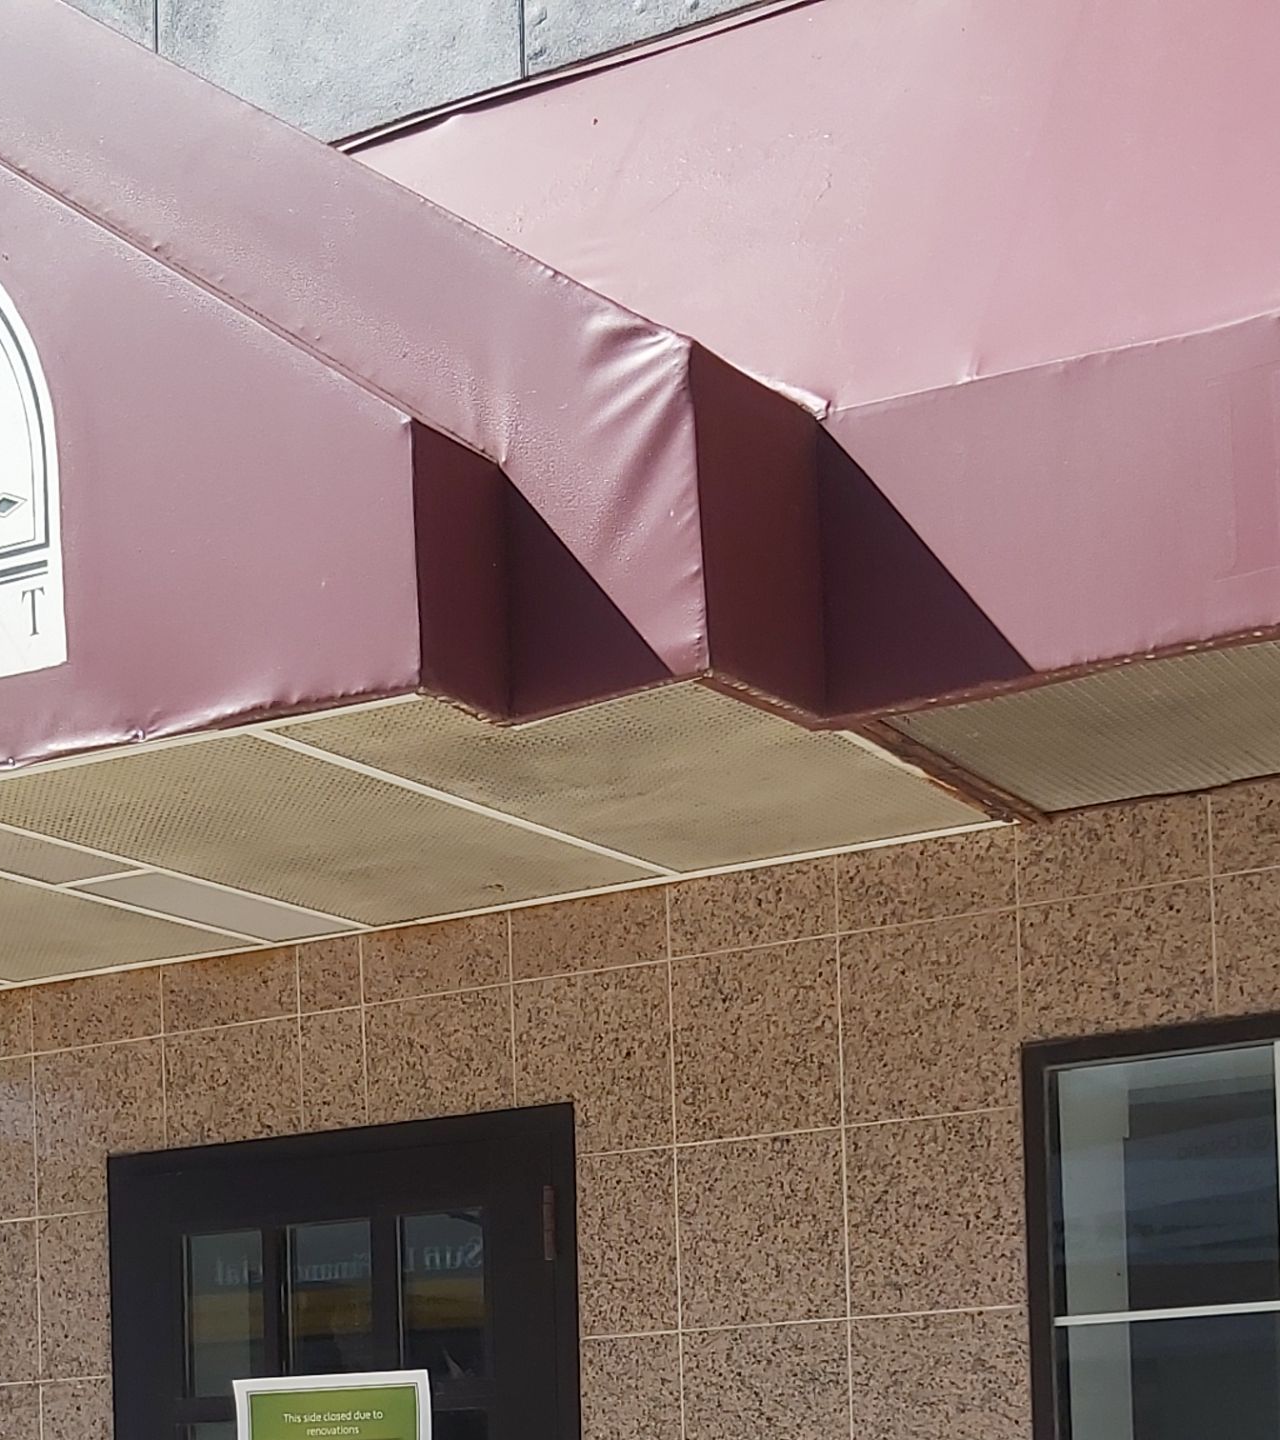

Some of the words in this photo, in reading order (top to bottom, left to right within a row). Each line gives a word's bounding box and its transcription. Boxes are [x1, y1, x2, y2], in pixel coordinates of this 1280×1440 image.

[283, 1413, 301, 1423] This
[303, 1412, 321, 1422] side
[323, 1411, 352, 1422] closed
[353, 1410, 371, 1420] due
[373, 1410, 383, 1419] to
[307, 1425, 359, 1436] renovations
